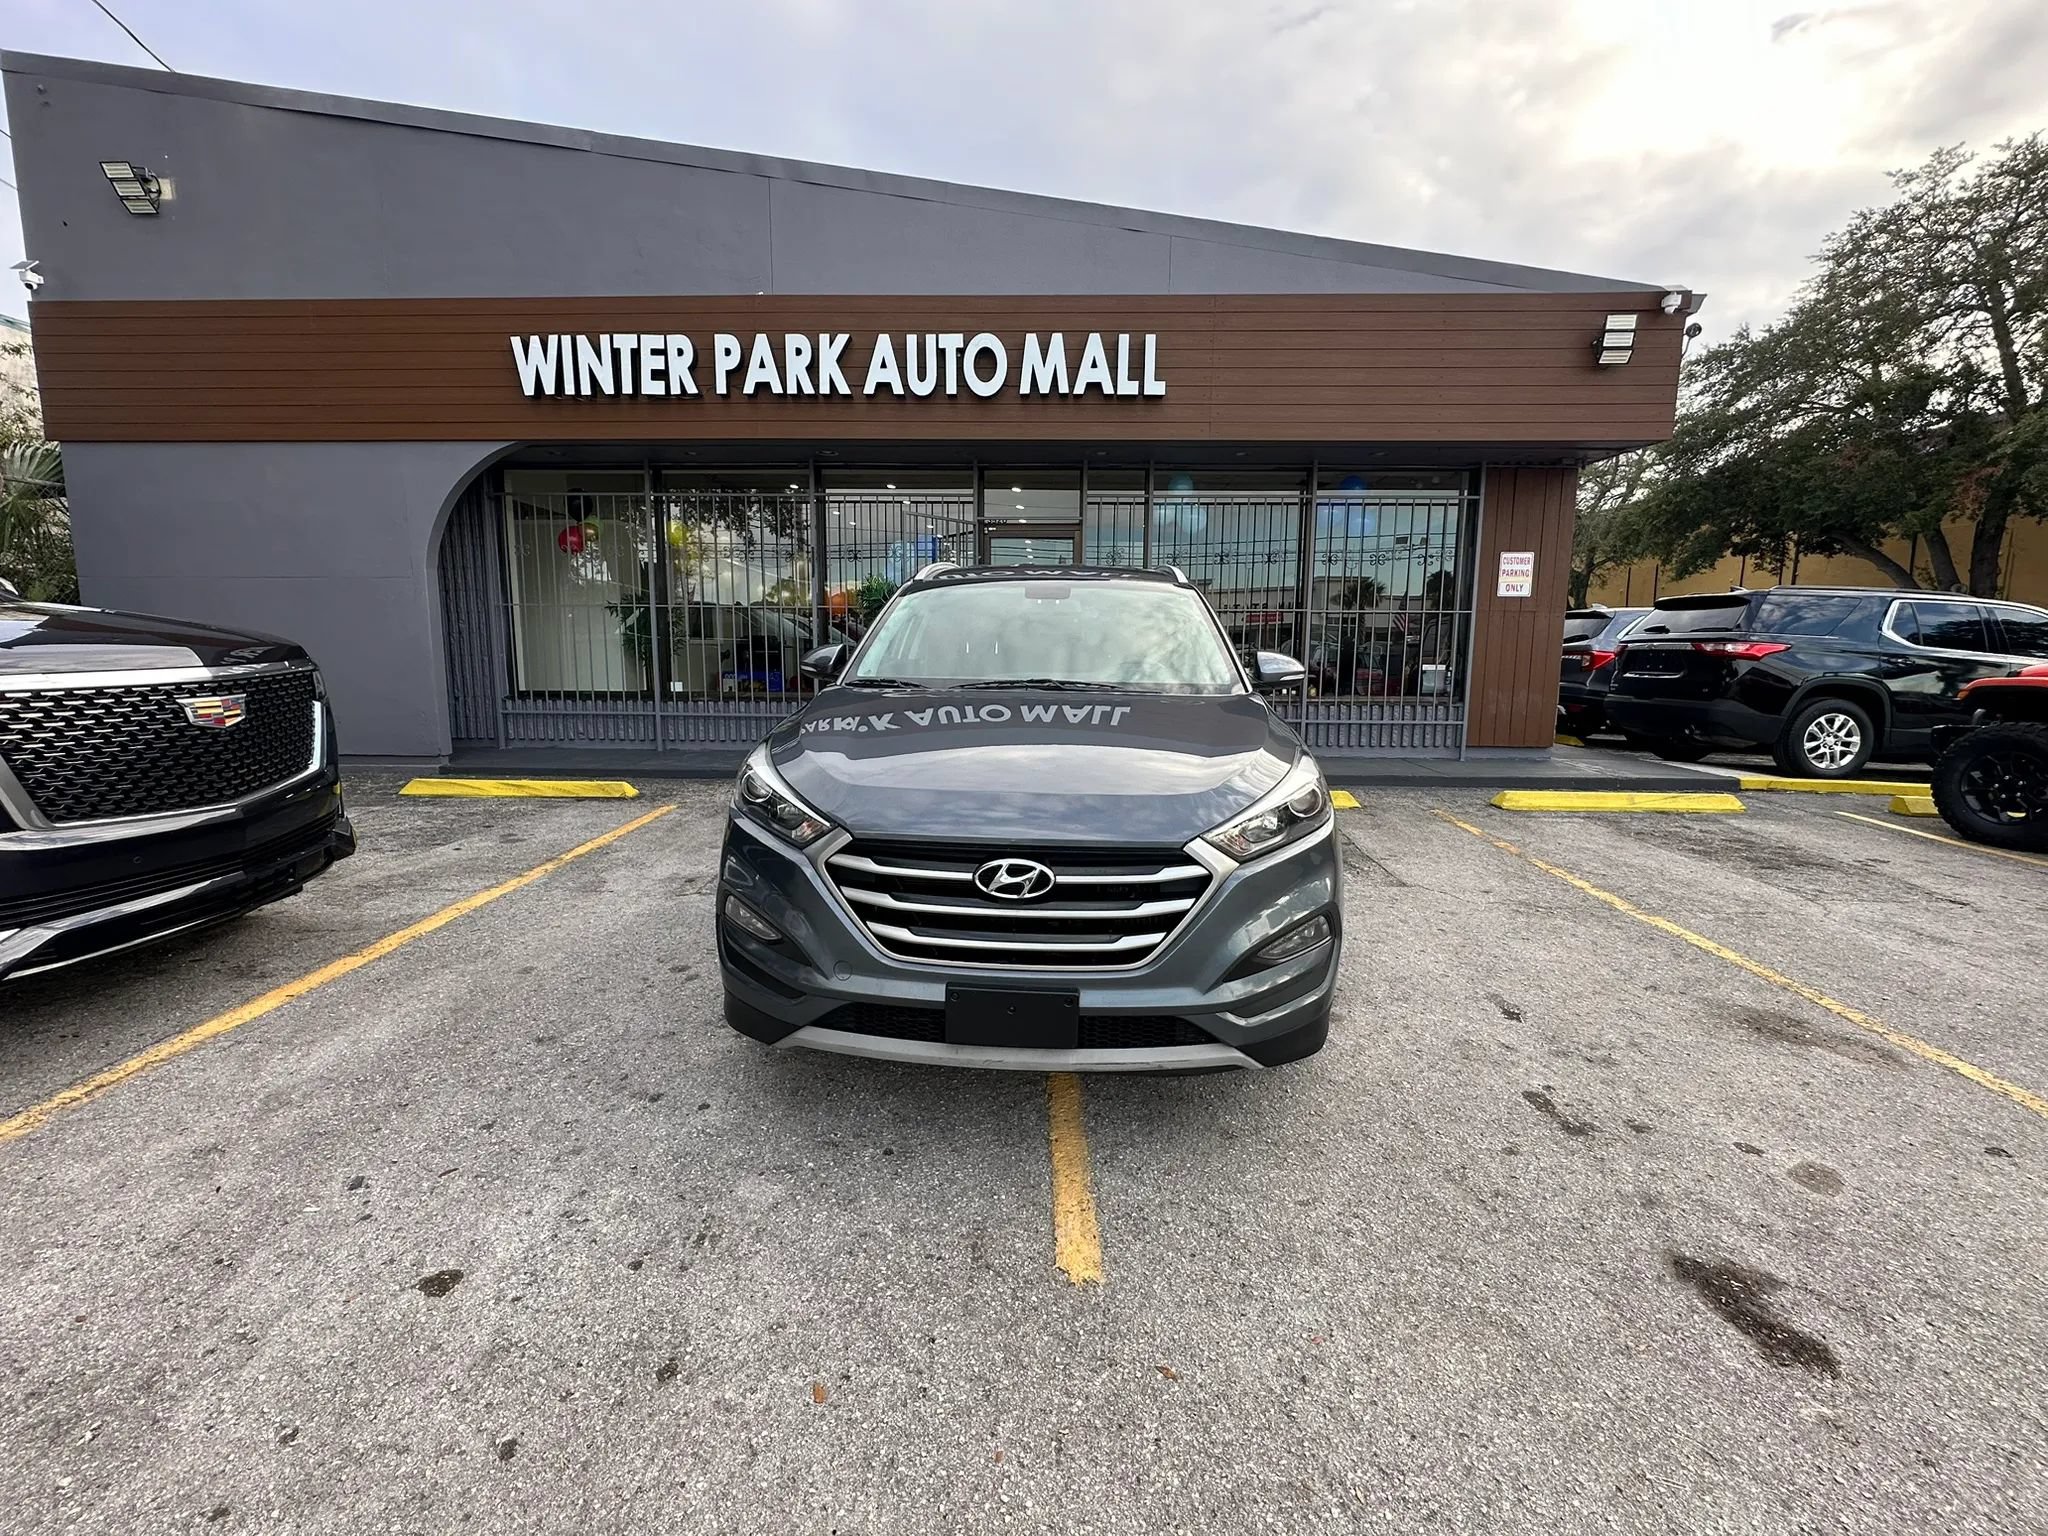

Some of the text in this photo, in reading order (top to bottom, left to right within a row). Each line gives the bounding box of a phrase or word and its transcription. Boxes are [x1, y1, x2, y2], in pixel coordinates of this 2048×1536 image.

[509, 332, 1167, 397] WINTER PARK AUTO MALL
[1502, 556, 1531, 566] CUSTOMER
[1501, 569, 1530, 578] PARKING
[1505, 583, 1524, 593] ONLY
